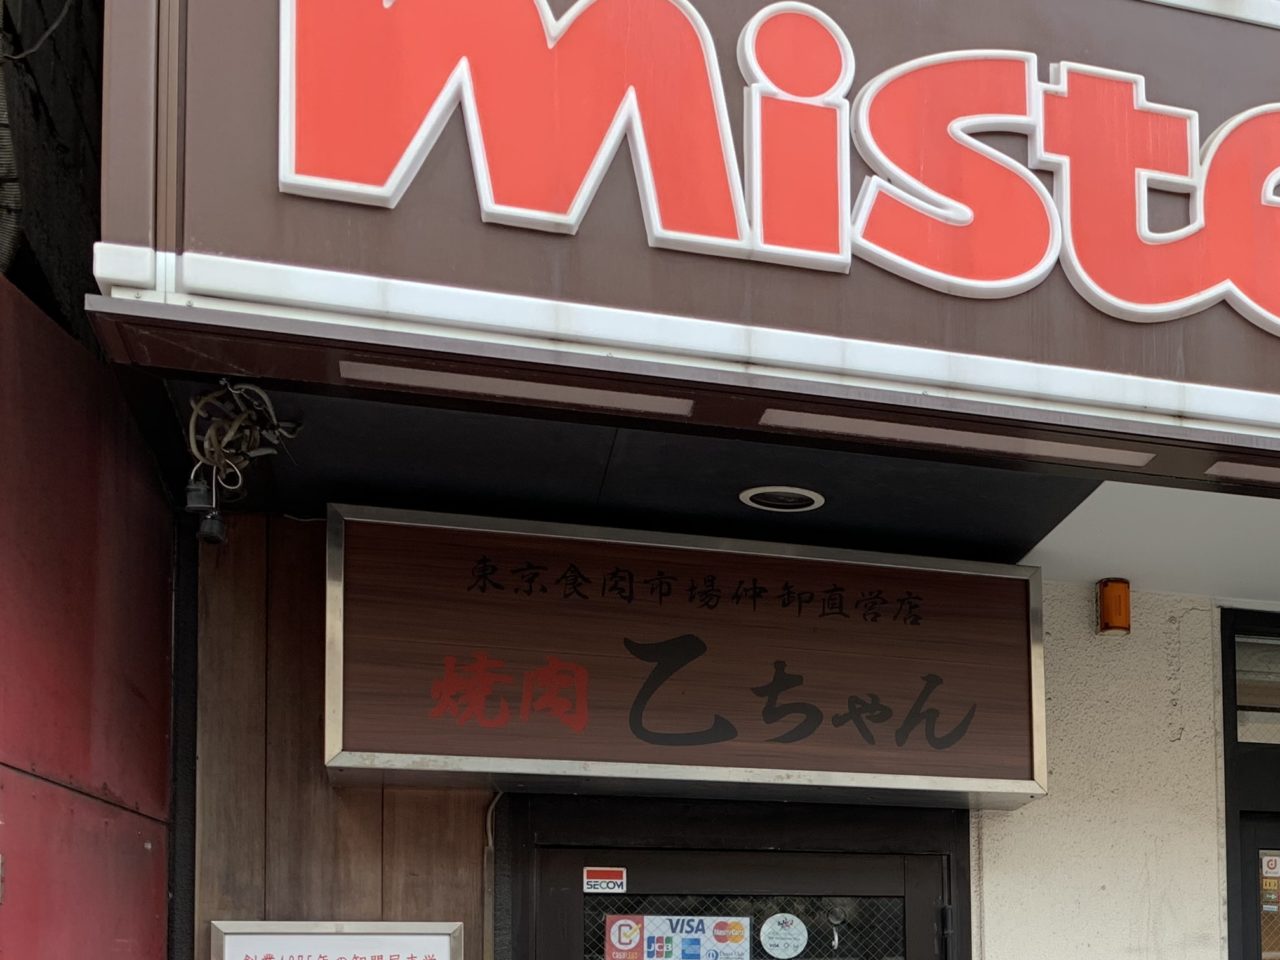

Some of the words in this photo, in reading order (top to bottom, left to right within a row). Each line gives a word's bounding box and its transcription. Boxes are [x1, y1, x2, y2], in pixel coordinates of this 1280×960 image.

[465, 555, 925, 627] 東京食肉市場仲卸直営店
[428, 650, 592, 734] 焼肉
[623, 633, 978, 751] 乙ちゃん
[586, 880, 624, 891] SECOM
[667, 918, 707, 935] VISA
